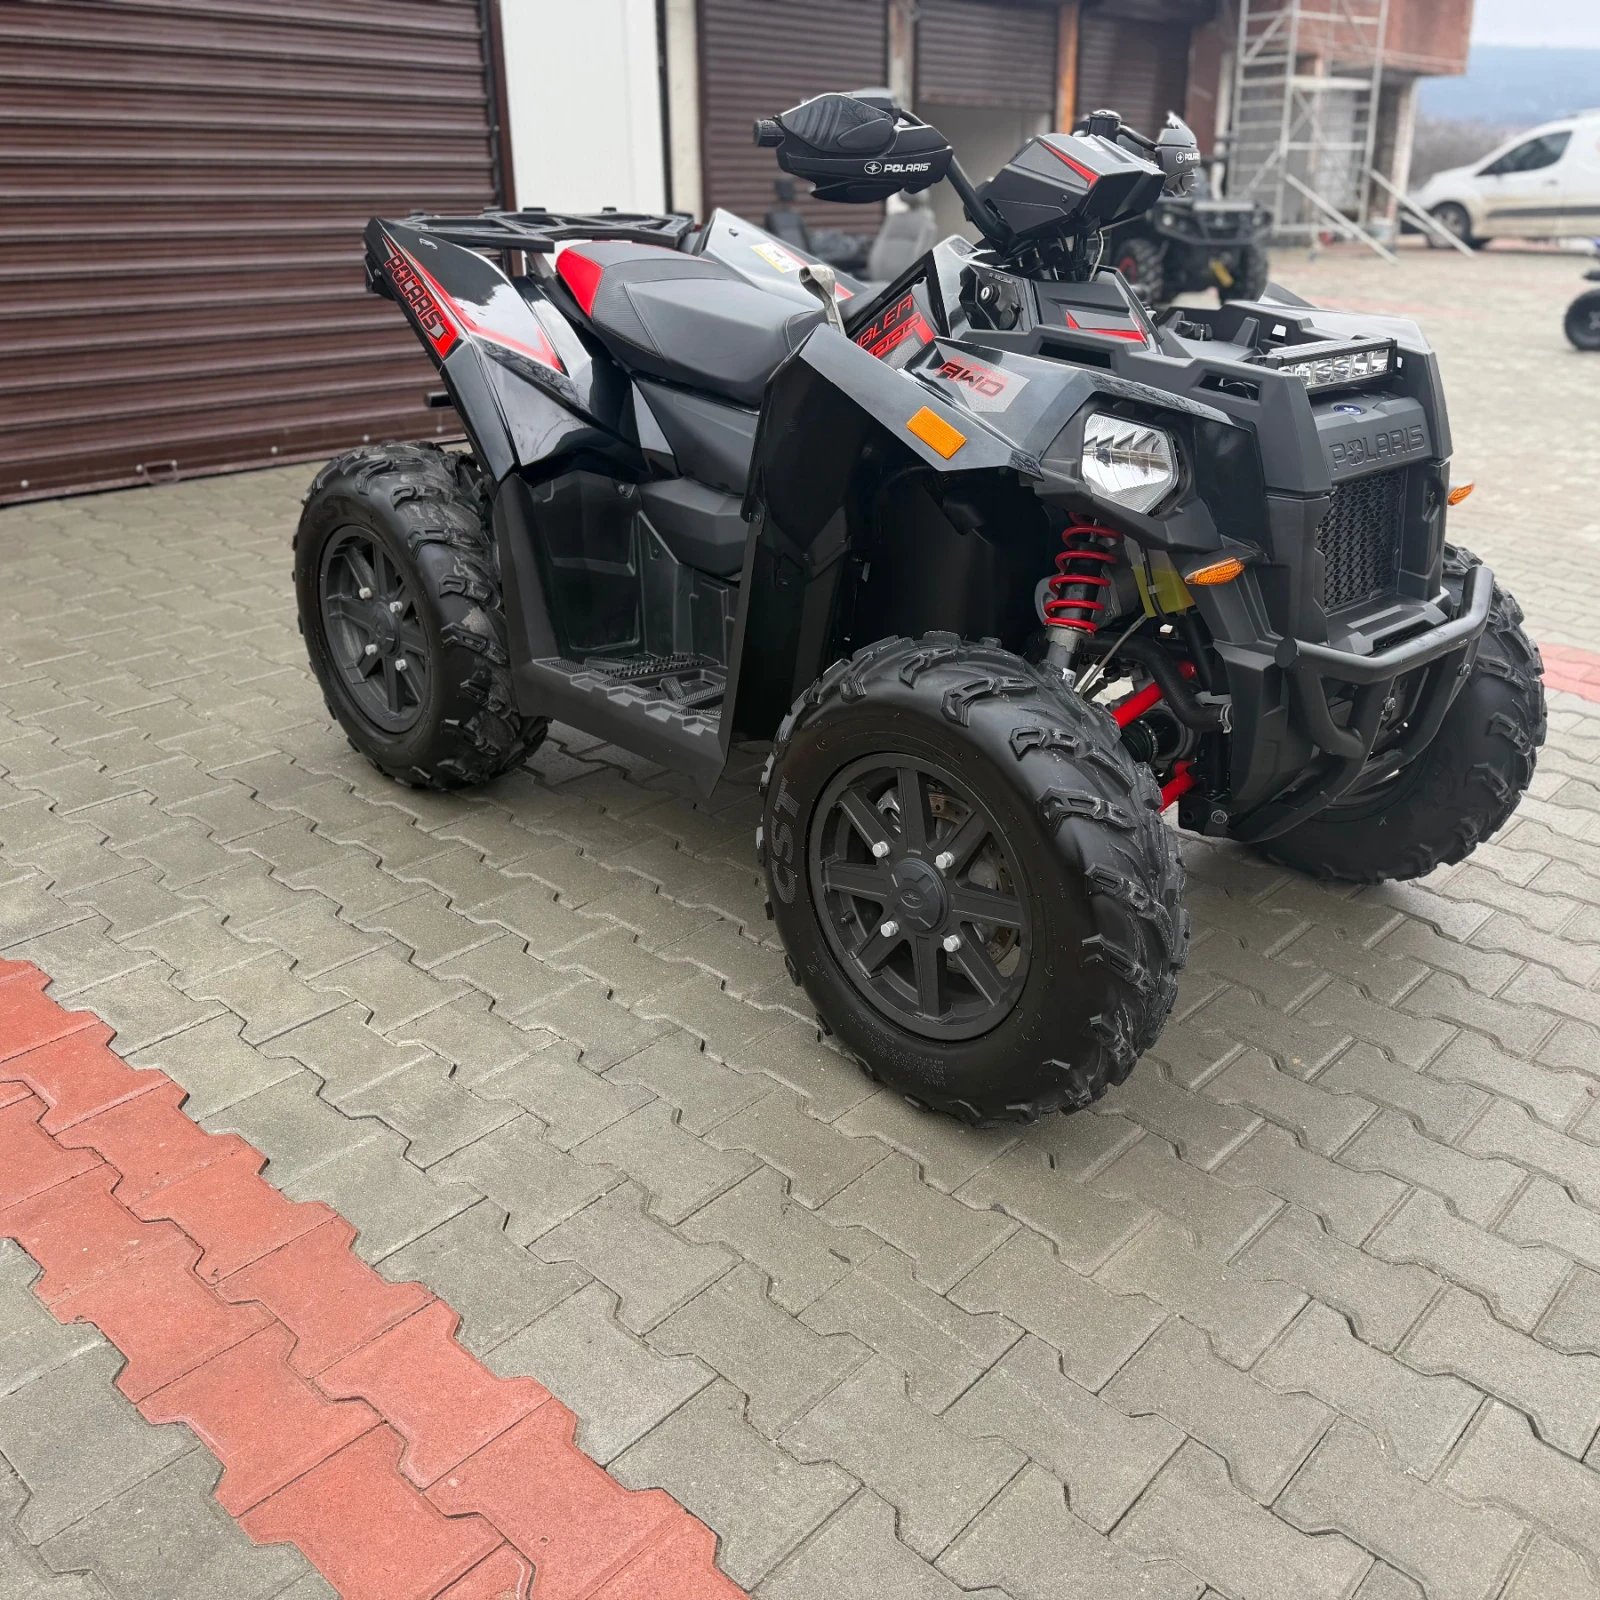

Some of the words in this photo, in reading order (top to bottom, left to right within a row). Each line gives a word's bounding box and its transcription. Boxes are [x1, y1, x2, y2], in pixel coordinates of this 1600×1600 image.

[883, 162, 932, 173] POLARIS
[384, 253, 450, 342] POLARIS
[856, 293, 913, 348] BLER
[934, 361, 1006, 399] AWD
[1329, 425, 1425, 471] POLARIS
[771, 775, 801, 904] CST
